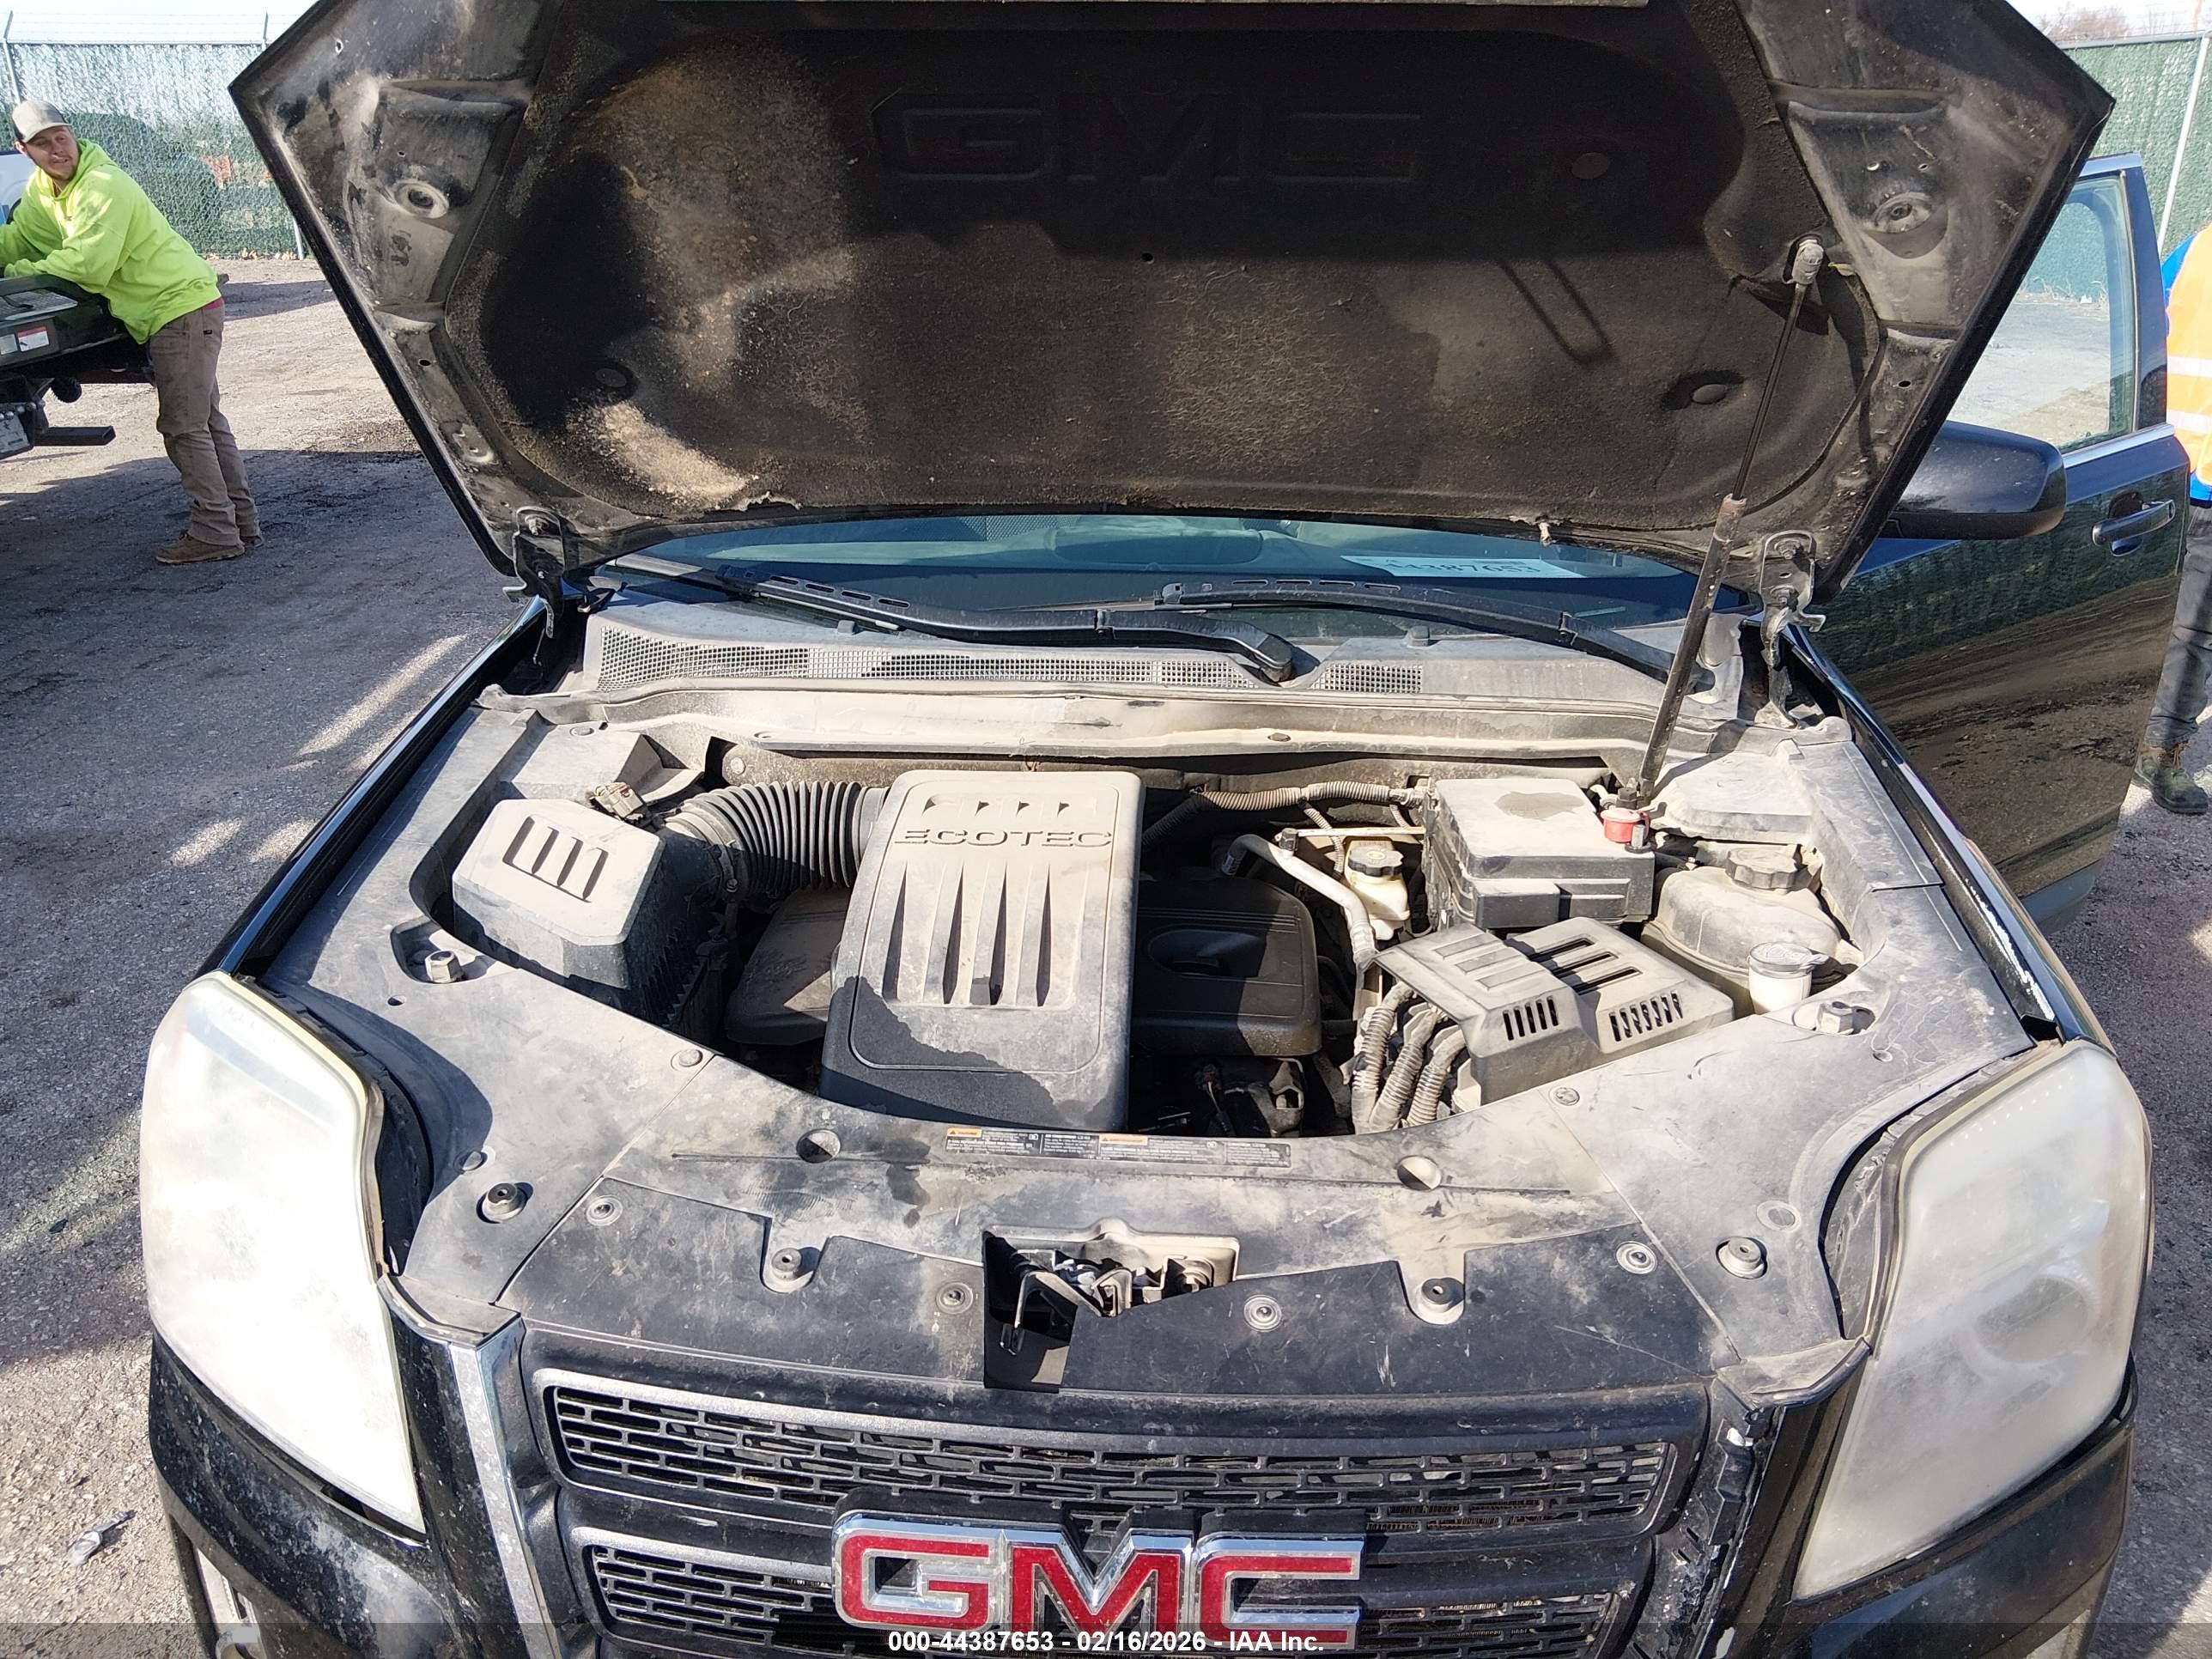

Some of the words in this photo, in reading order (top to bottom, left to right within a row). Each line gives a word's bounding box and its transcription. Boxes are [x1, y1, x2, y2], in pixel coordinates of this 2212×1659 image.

[874, 93, 1425, 184] GMC
[894, 828, 1112, 848] ECOTEC
[832, 1509, 1365, 1650] GMC
